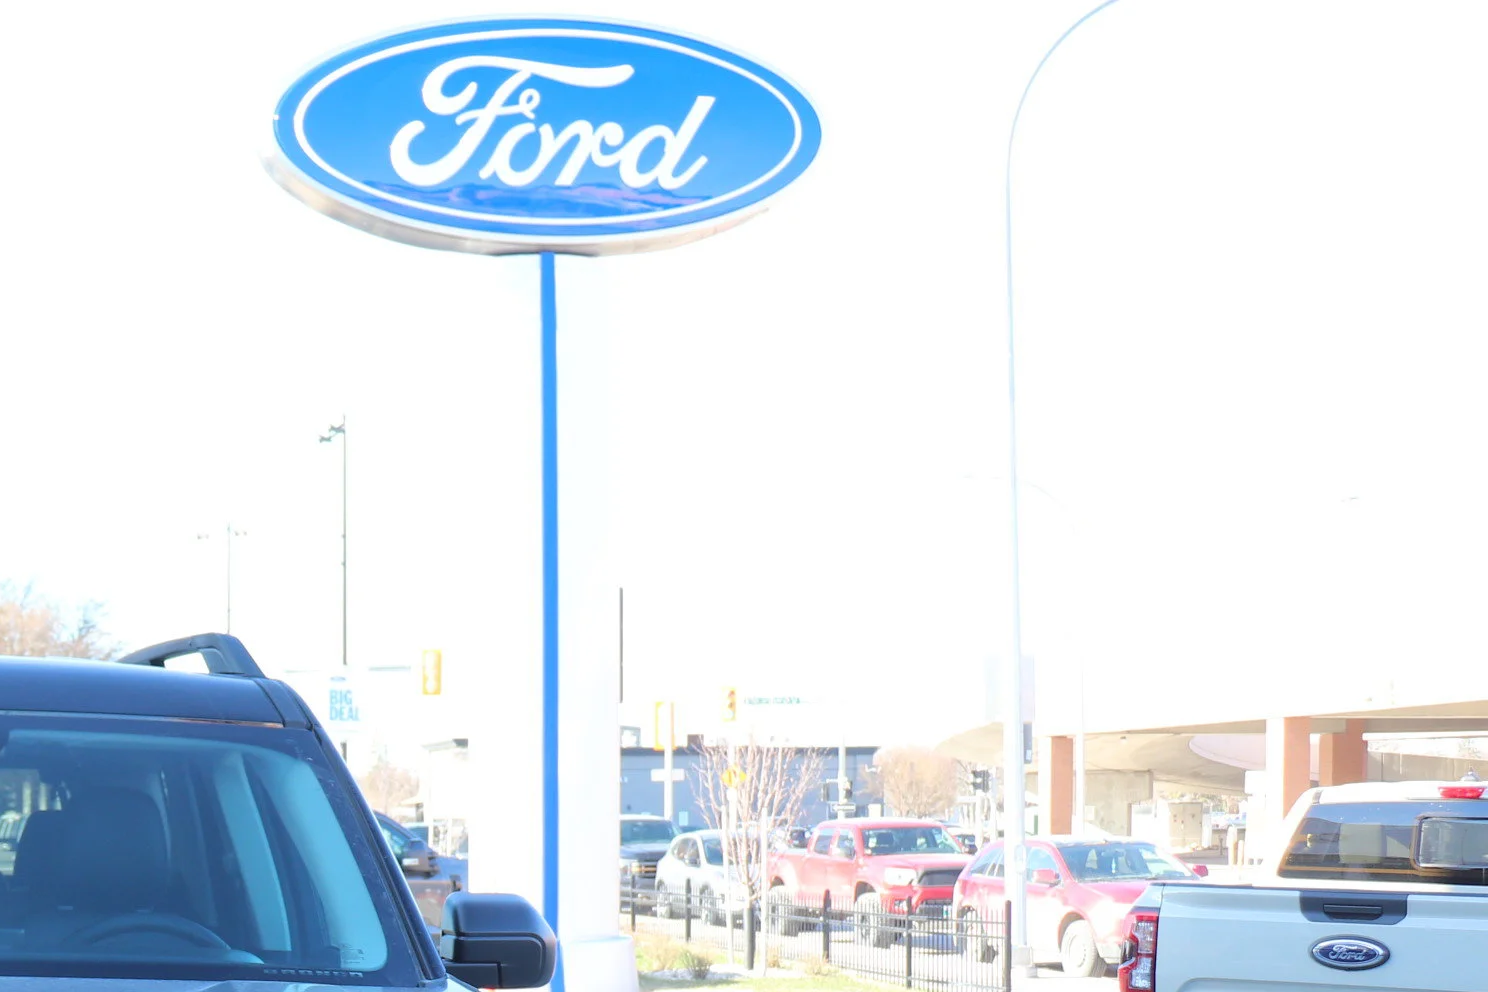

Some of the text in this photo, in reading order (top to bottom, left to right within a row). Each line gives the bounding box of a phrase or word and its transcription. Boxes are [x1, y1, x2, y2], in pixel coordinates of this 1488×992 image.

[389, 55, 716, 190] Ford
[329, 689, 353, 705] BIG
[329, 705, 361, 722] DEAL
[1328, 944, 1367, 961] Ford
